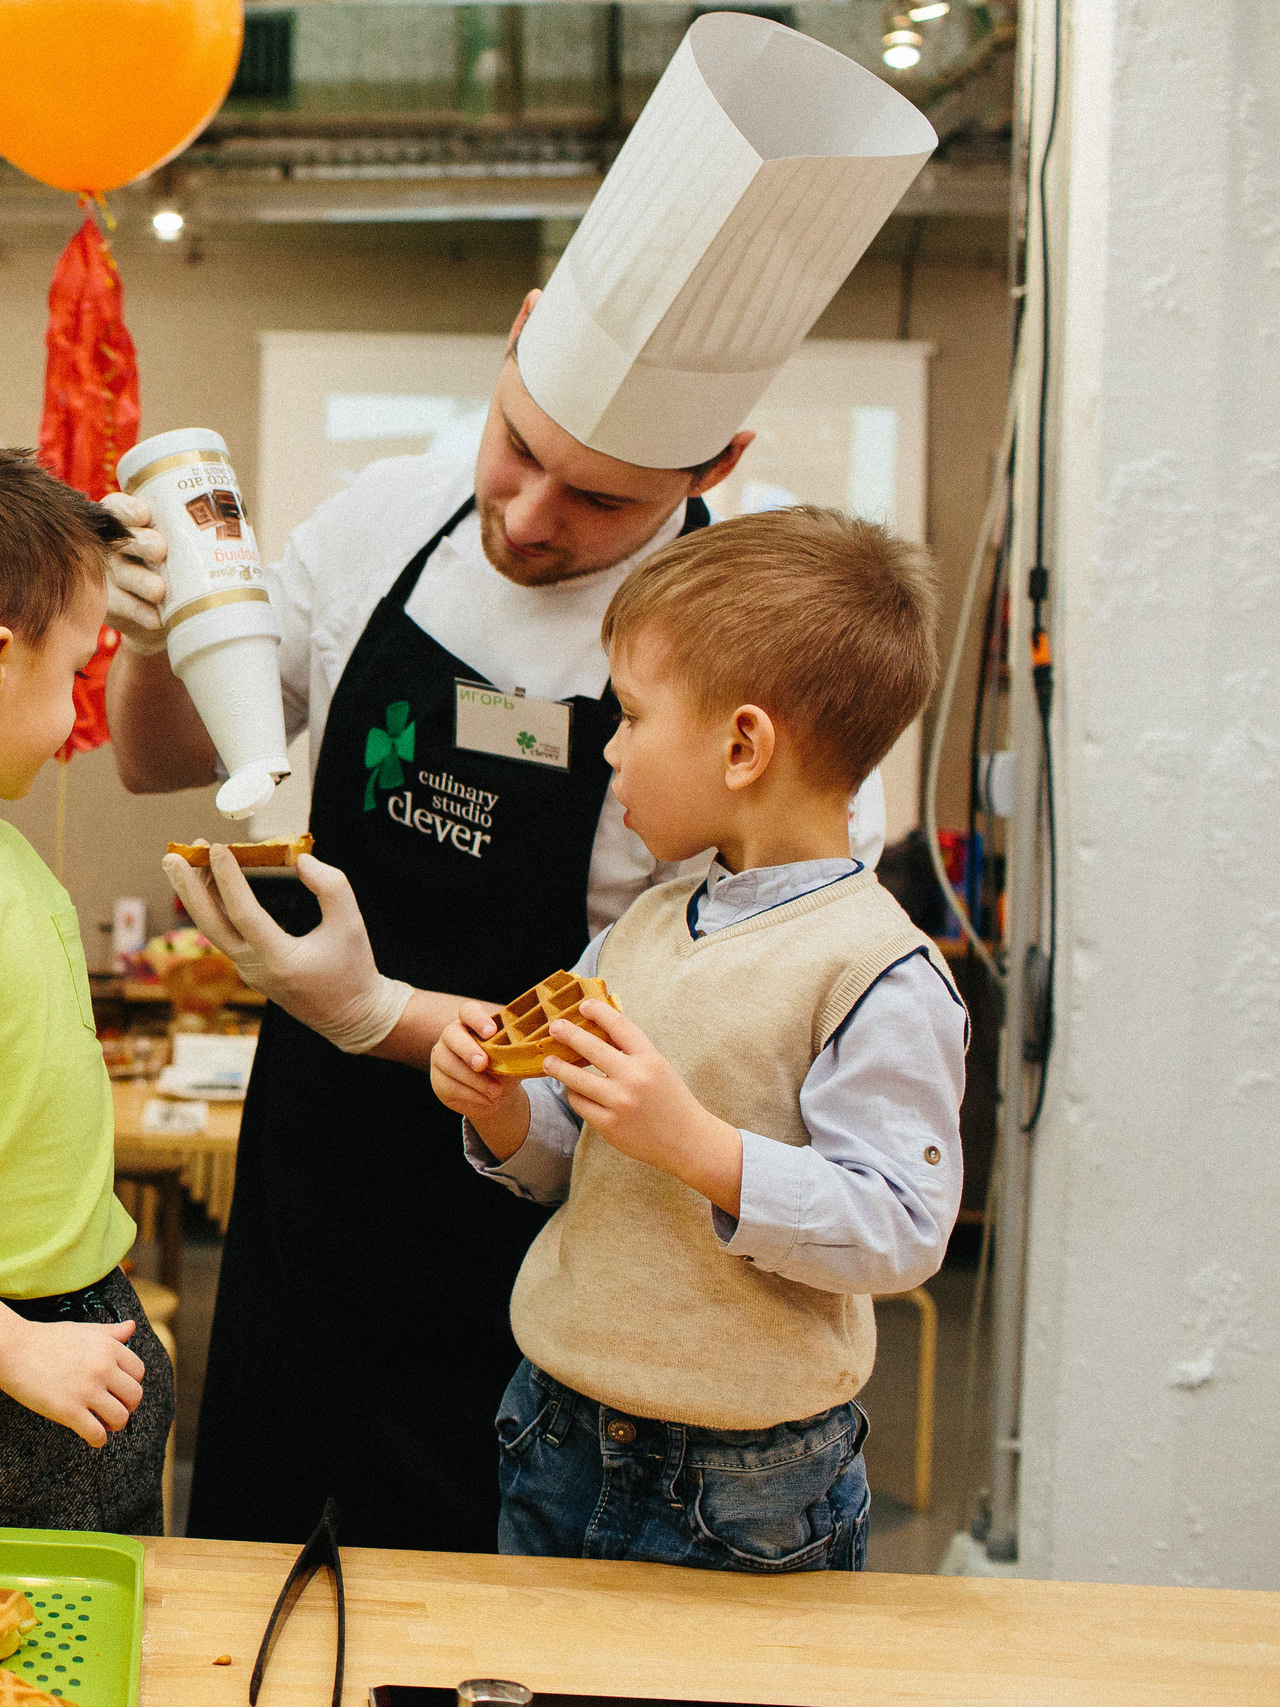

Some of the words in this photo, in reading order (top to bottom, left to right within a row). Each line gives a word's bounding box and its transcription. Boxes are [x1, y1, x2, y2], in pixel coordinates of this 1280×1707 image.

[460, 689, 515, 710] ИГОРЬ
[419, 770, 499, 811] culinary
[388, 791, 491, 858] clever
[432, 795, 492, 827] studio
